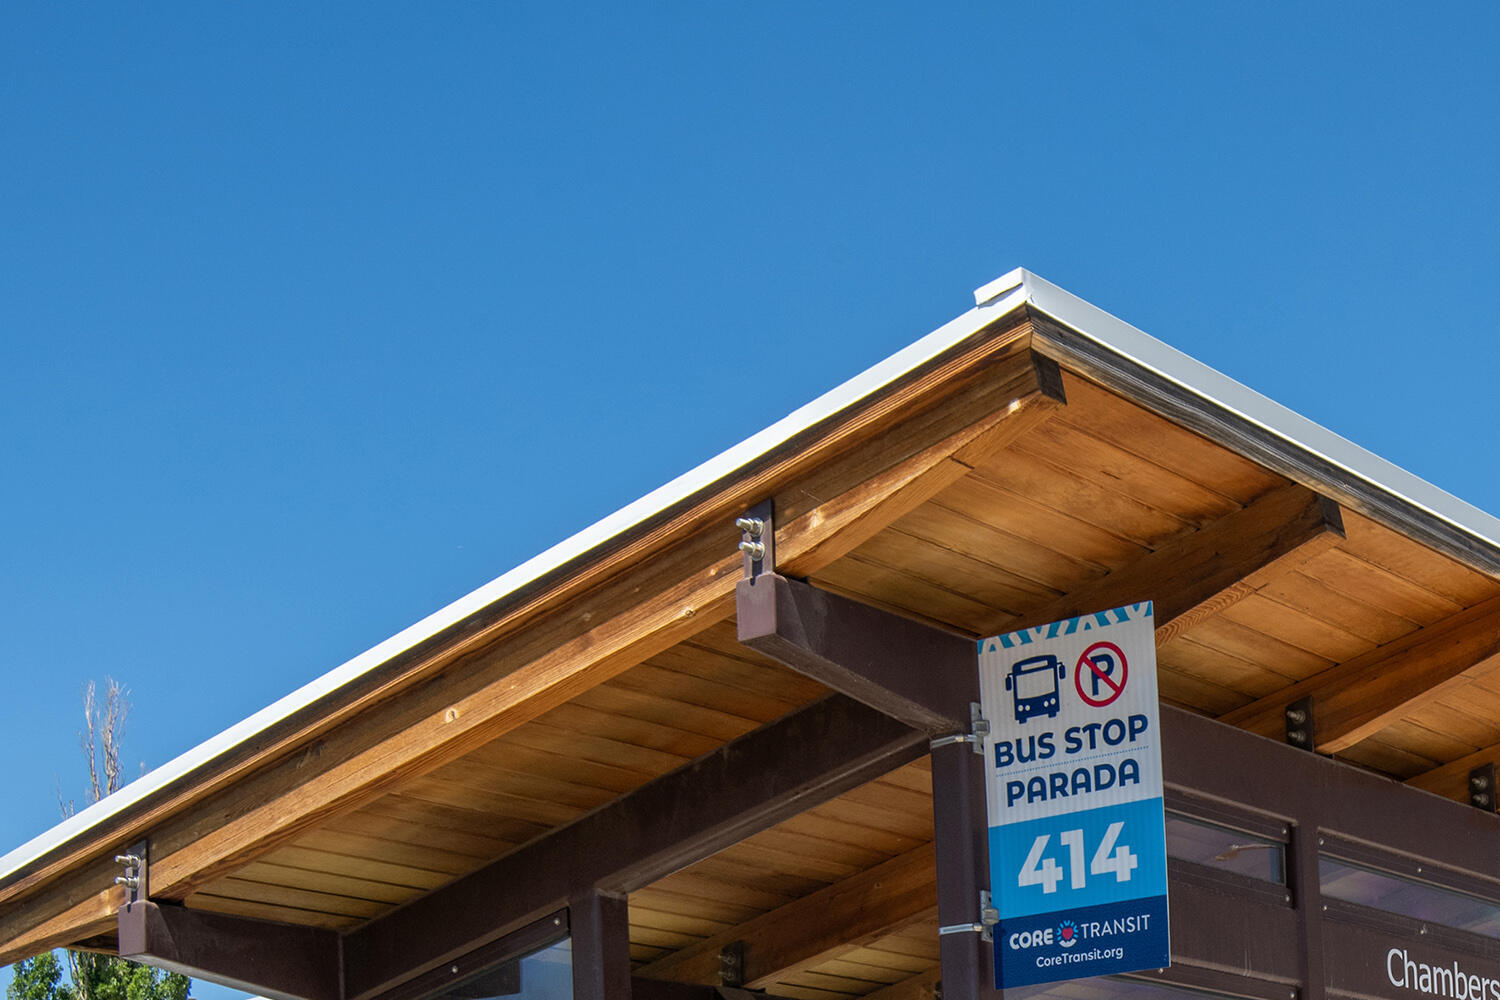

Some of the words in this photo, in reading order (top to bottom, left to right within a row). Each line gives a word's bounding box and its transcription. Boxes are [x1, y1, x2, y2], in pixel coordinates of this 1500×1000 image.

[994, 731, 1055, 769] BUS
[1065, 713, 1149, 754] STOP
[1006, 758, 1140, 807] PARADA
[1018, 821, 1138, 895] 414
[1009, 927, 1054, 951] CORE
[1080, 914, 1151, 940] TRANSIT
[1036, 946, 1124, 968] CoreTransit.org
